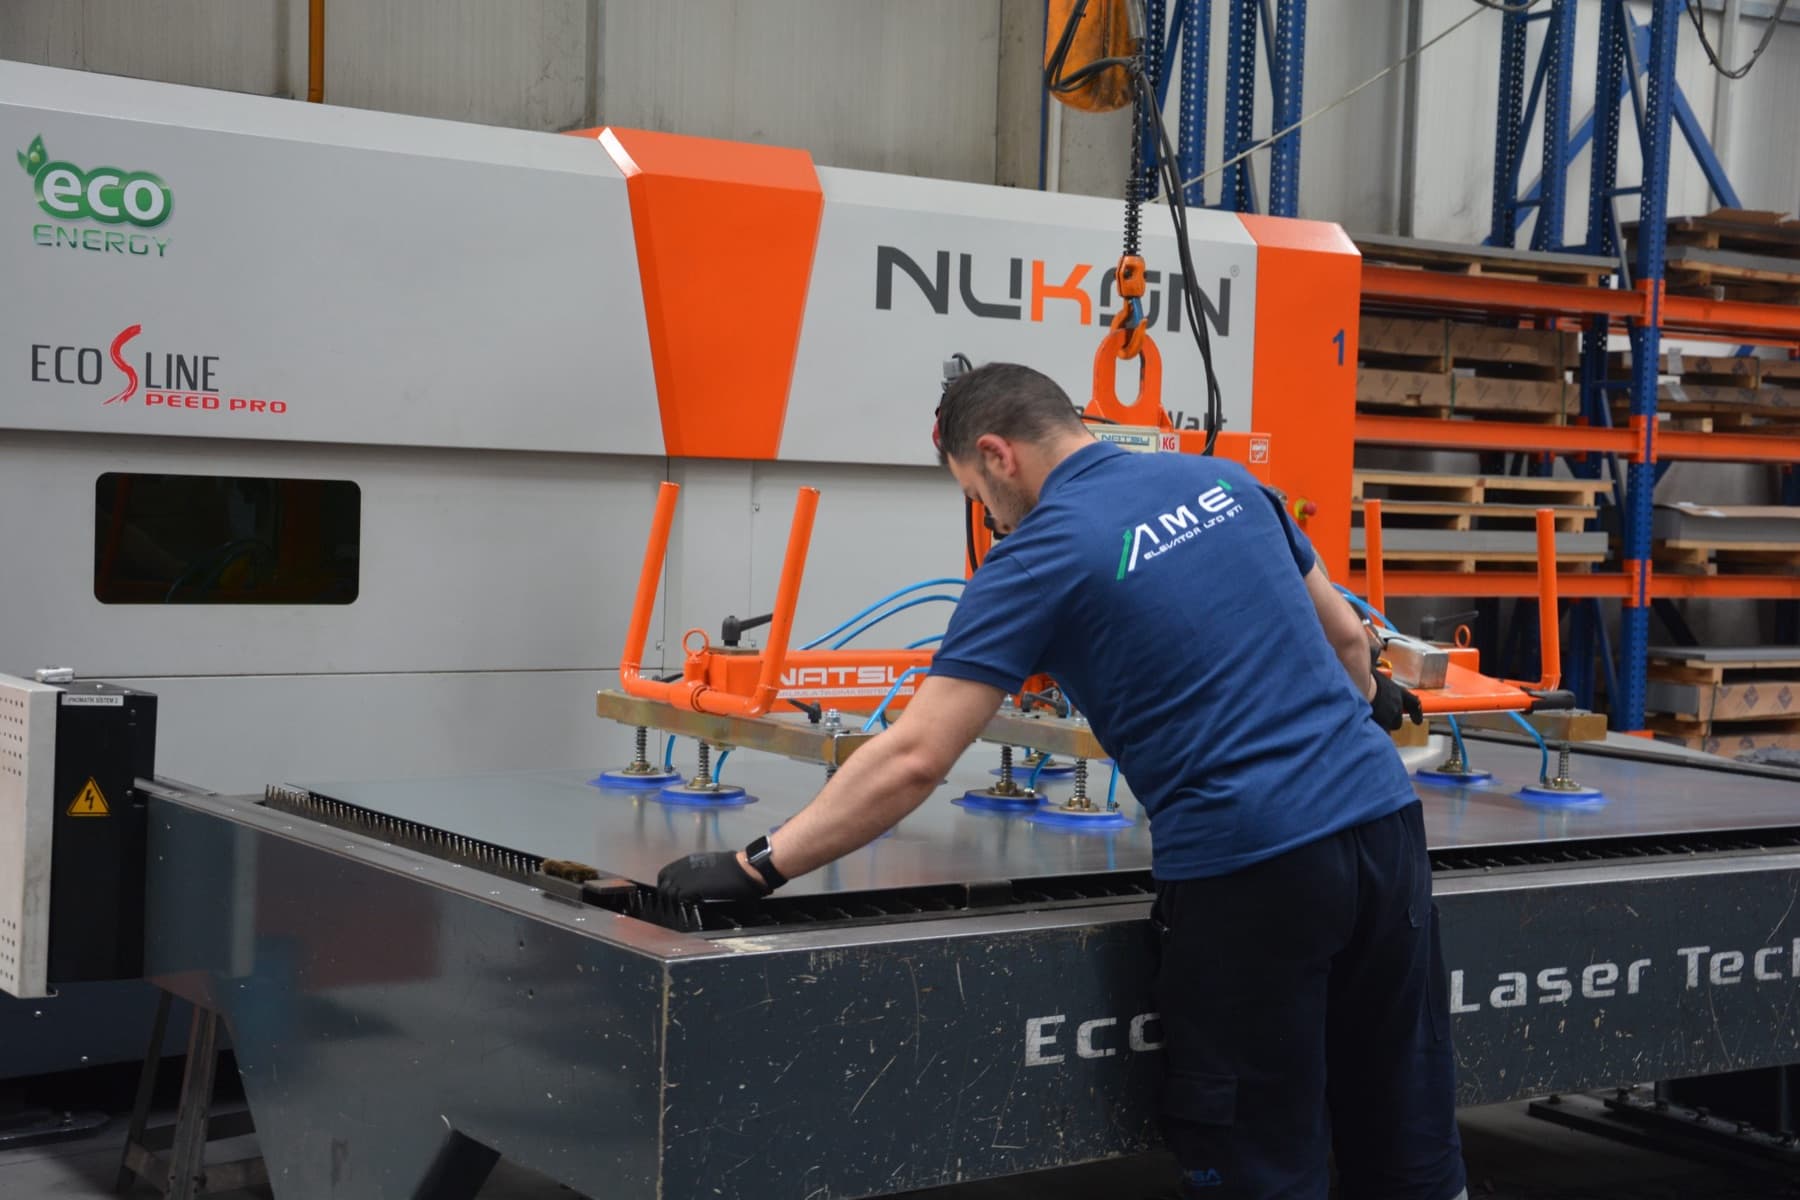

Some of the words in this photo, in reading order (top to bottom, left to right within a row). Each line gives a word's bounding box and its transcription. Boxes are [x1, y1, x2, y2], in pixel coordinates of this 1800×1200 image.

[43, 169, 164, 220] eco
[33, 224, 173, 257] ENERGY
[31, 344, 102, 385] ECO
[1332, 328, 1345, 367] 1
[229, 398, 287, 414] PRO
[1162, 436, 1175, 451] KG
[1127, 484, 1235, 573] AME
[1143, 526, 1202, 560] ELEVATOR
[1203, 514, 1225, 529] LTD
[780, 665, 916, 686] NATSU
[1450, 958, 1651, 1014] Laser
